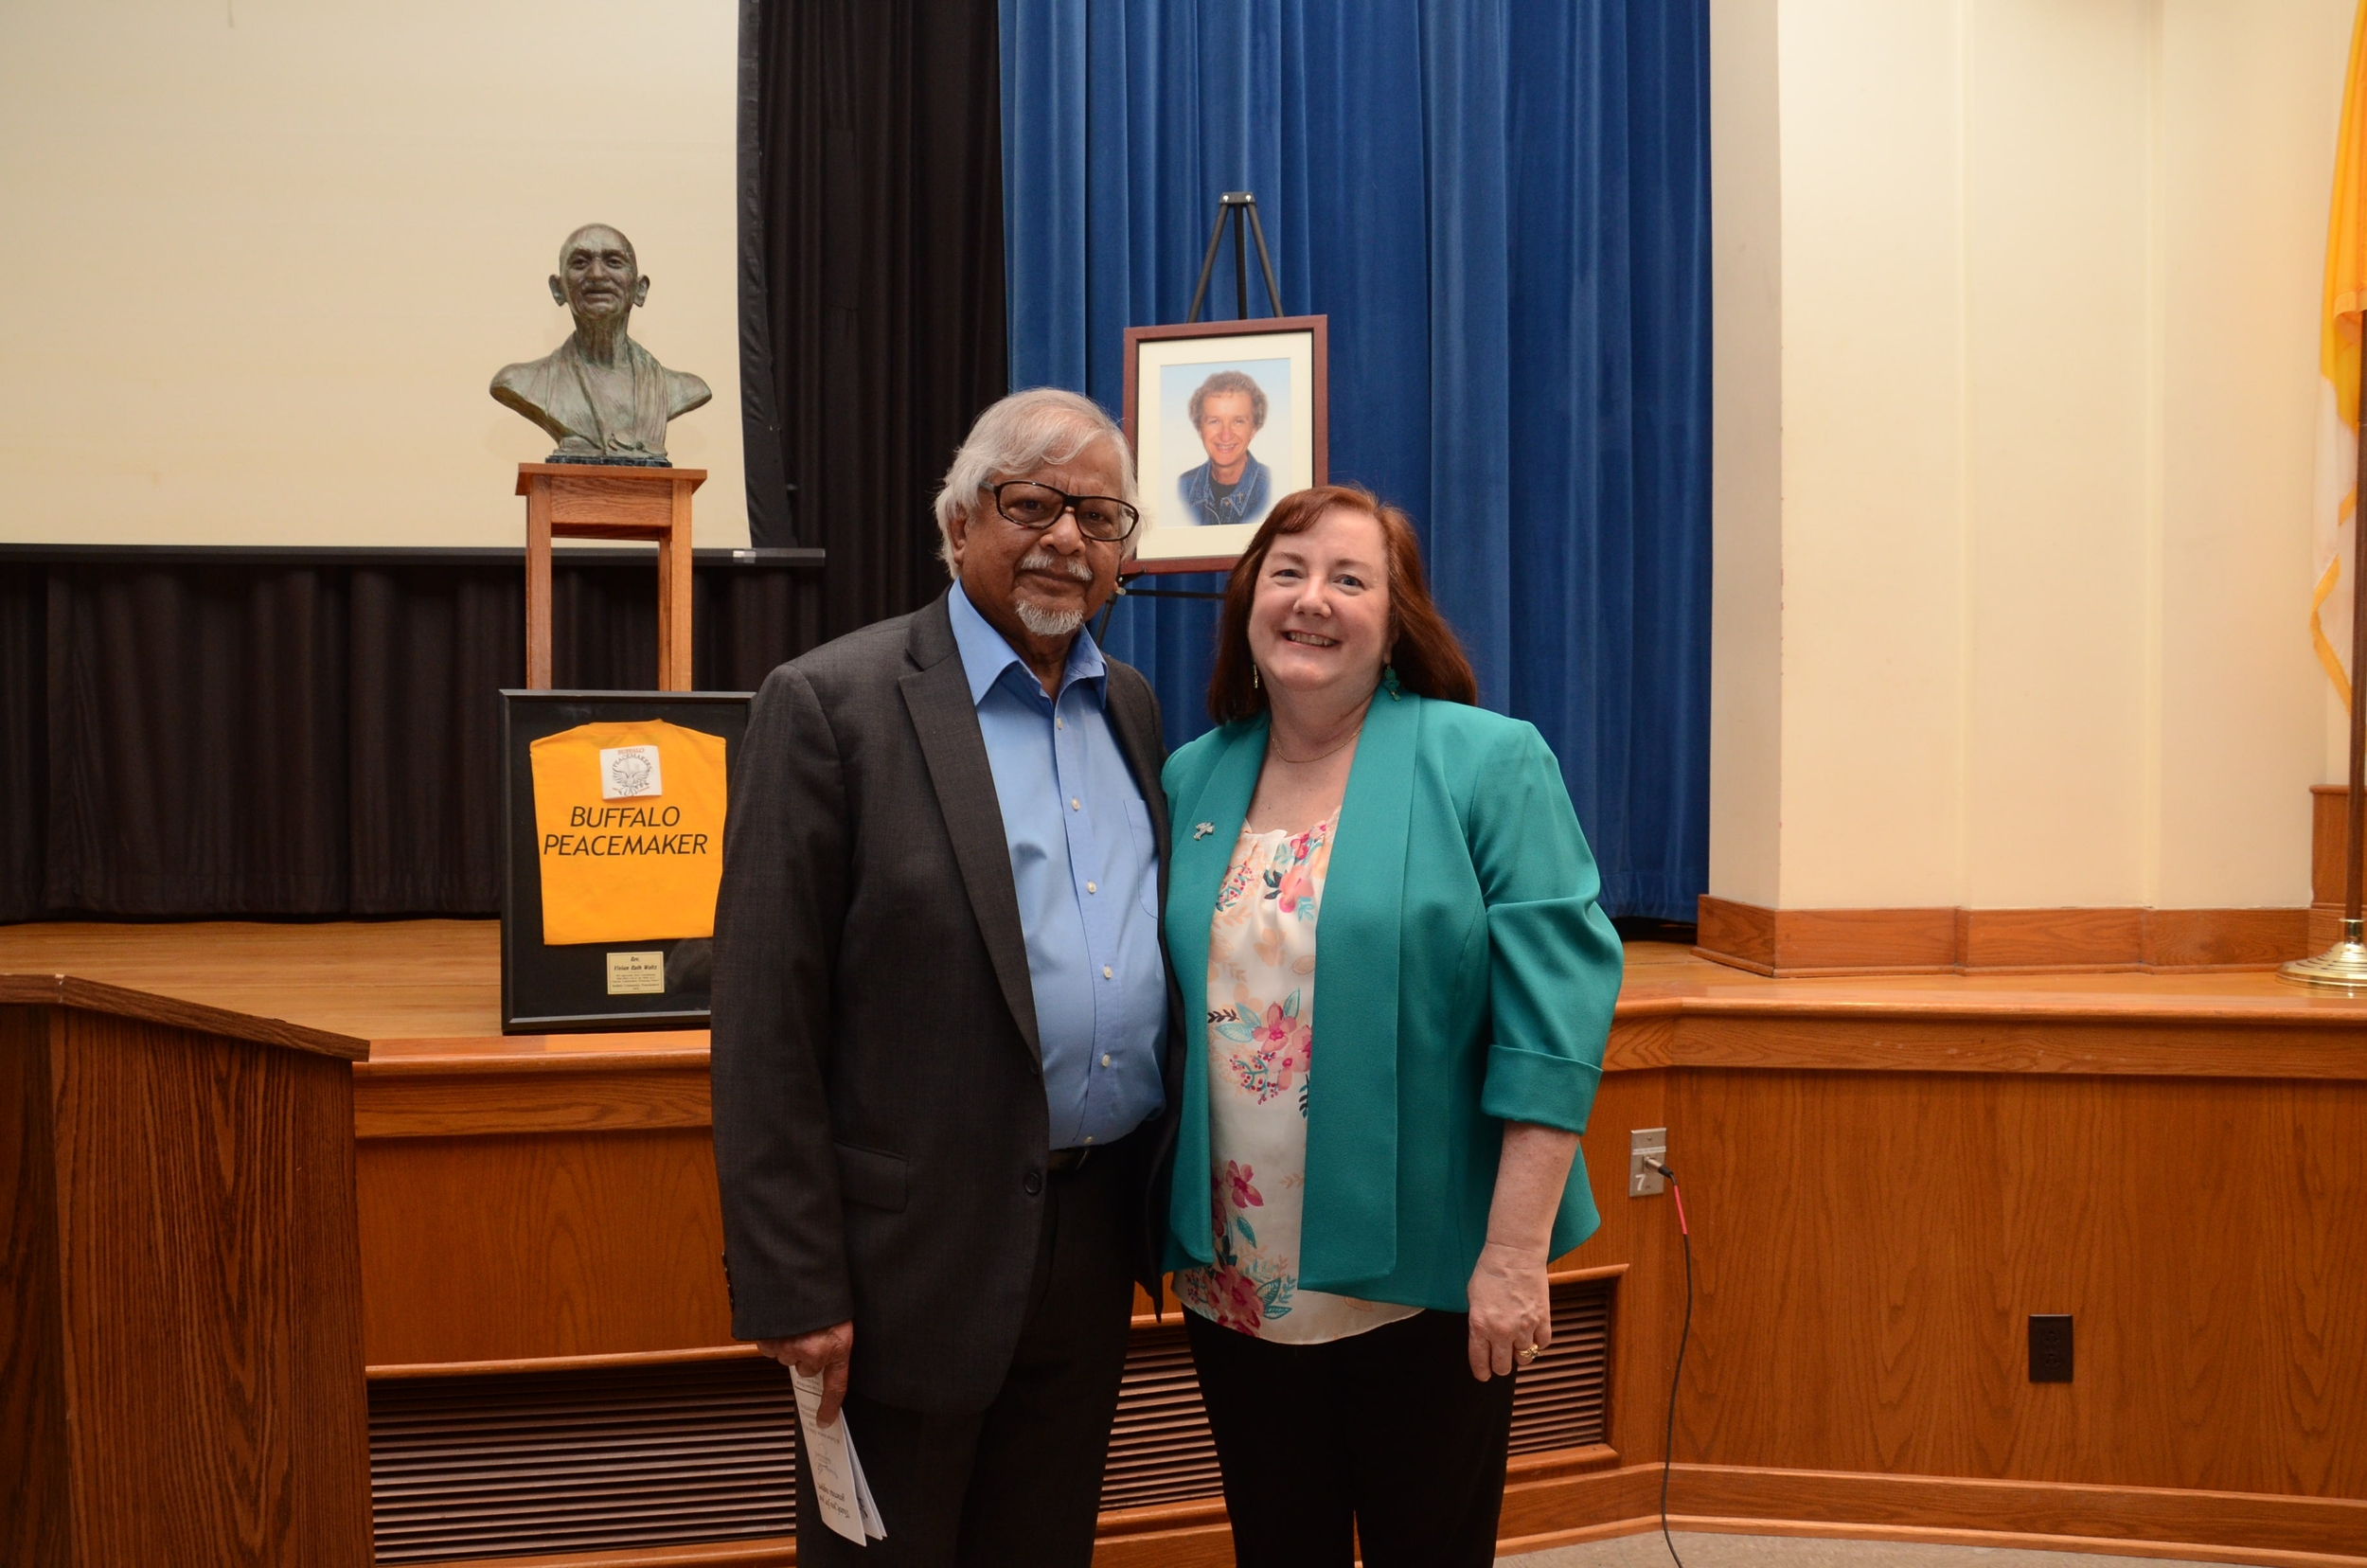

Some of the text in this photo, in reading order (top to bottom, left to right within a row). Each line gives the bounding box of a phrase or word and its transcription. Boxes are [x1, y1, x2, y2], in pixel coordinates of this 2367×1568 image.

[617, 747, 645, 756] BUFFALO
[613, 754, 652, 769] PEACEMAKERS
[570, 806, 681, 829] BUFFALO
[543, 833, 708, 856] PEACEMAKER
[1635, 1174, 1646, 1191] 7
